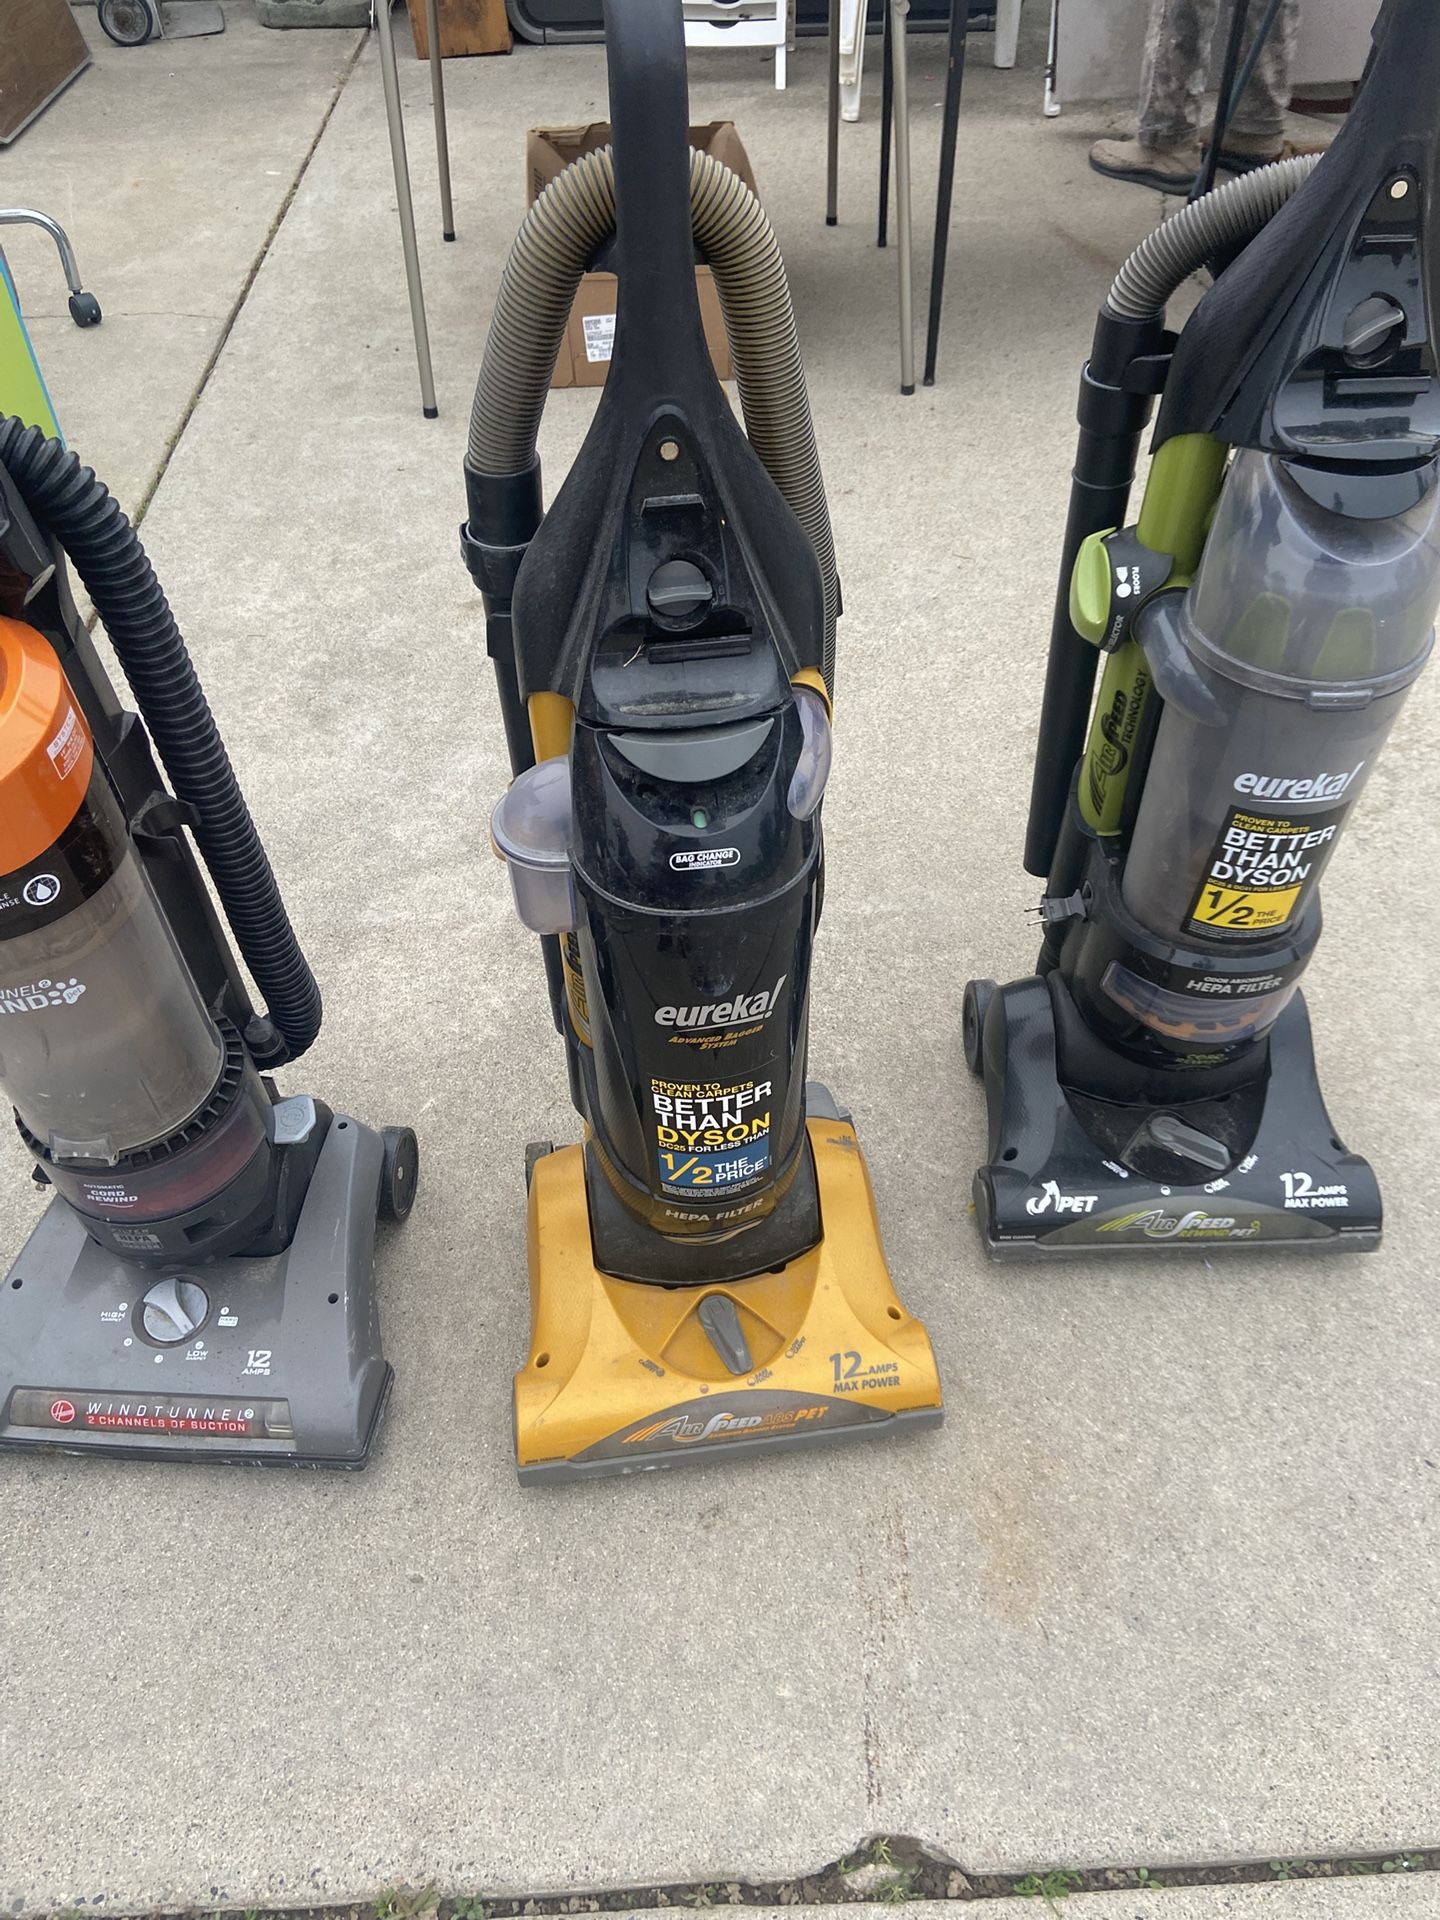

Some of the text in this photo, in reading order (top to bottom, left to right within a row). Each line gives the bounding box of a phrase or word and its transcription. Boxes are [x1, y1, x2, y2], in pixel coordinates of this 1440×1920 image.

[1131, 566, 1141, 595] FLOORS
[1122, 669, 1148, 744] TECHNOLOGY
[1233, 760, 1366, 801] eureka!
[1231, 820, 1310, 834] CLEAN CARPETS
[1233, 813, 1275, 827] PROVEN
[1224, 825, 1337, 851] BETTER
[675, 850, 734, 864] BAG CHANGE
[688, 860, 722, 868] INDICATOR
[1221, 844, 1303, 869] THAN
[1210, 861, 1313, 886] DYSON
[1206, 890, 1255, 926] 1/2
[1256, 910, 1278, 918] THE
[1186, 977, 1283, 994] HEPA FILTER
[1203, 976, 1230, 984] ODOR
[654, 973, 787, 1028] eureka!
[668, 1024, 764, 1044] ADVANCED BAGGED
[699, 1039, 738, 1050] SYSTEM
[651, 1078, 720, 1092] PROVEN TO
[651, 1081, 754, 1098] CLEAN CARPETS
[653, 1080, 772, 1115] BETTER
[655, 1109, 742, 1131] THAN
[657, 1111, 770, 1146] DYSON
[658, 1127, 770, 1153] DC25 FOR LESS THAN
[661, 1153, 713, 1184] 1/2
[714, 1156, 748, 1173] THE
[90, 1189, 125, 1197] CORD
[1279, 1171, 1347, 1199] 12 AMPS
[86, 1194, 138, 1203] REWIND
[1057, 1195, 1099, 1213] PET
[1284, 1197, 1349, 1208] MAX POWER
[665, 1198, 764, 1221] HEPA FILTER
[1178, 1228, 1257, 1238] REWIND PET
[101, 1311, 126, 1319] HIGH
[247, 1350, 272, 1368] 12
[829, 1351, 898, 1380] 12 AMPS
[242, 1367, 271, 1376] AMPS
[833, 1376, 901, 1393] MAX POWER
[87, 1402, 246, 1421] WINDTUNNEL
[794, 1406, 829, 1421] PET
[88, 1415, 246, 1432] 2 CHANNELS OF SUCTION
